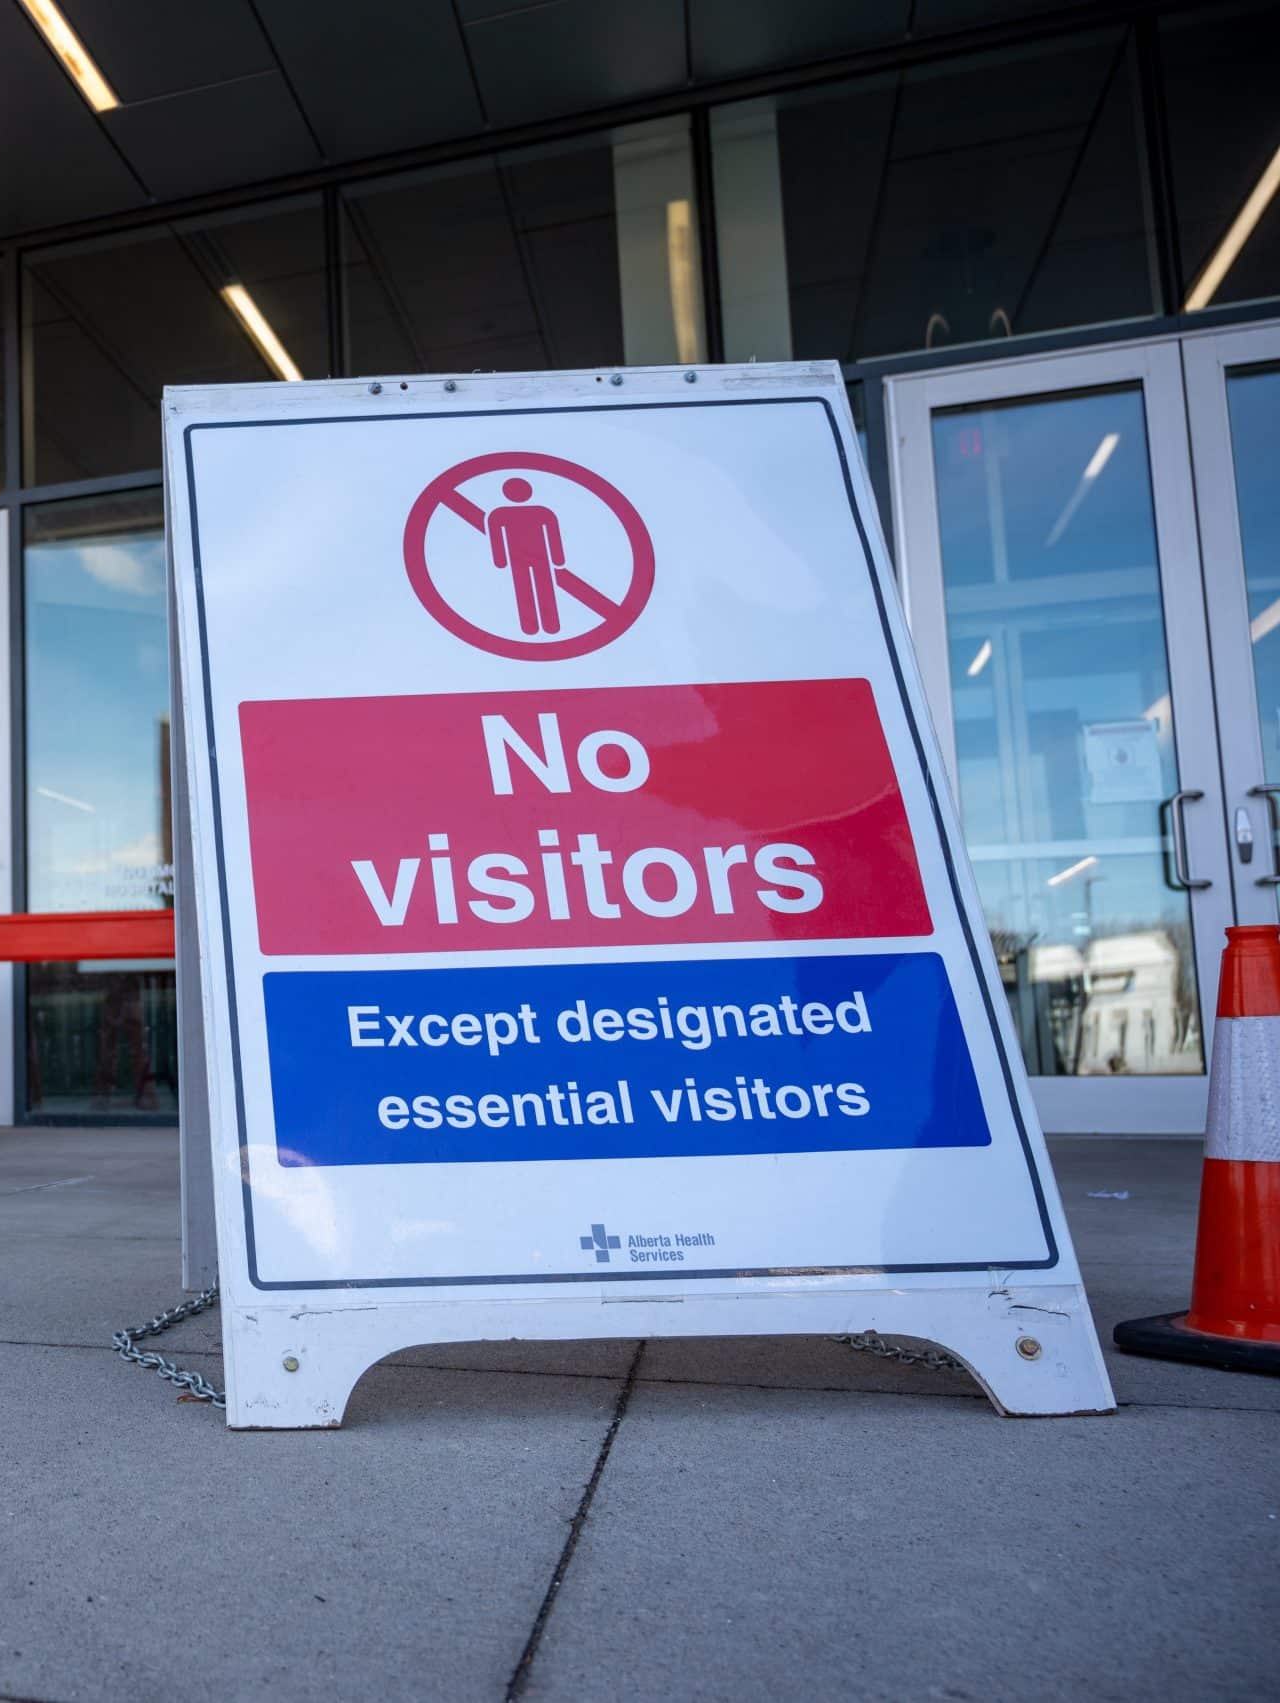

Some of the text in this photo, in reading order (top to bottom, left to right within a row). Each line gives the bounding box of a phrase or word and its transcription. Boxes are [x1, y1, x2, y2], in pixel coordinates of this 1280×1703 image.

[480, 712, 651, 796] No
[350, 828, 825, 927] visitors
[347, 991, 872, 1056] Except designated
[377, 1075, 871, 1129] essential visitors
[627, 1233, 716, 1248] Alberta Health
[629, 1249, 685, 1263] Services
